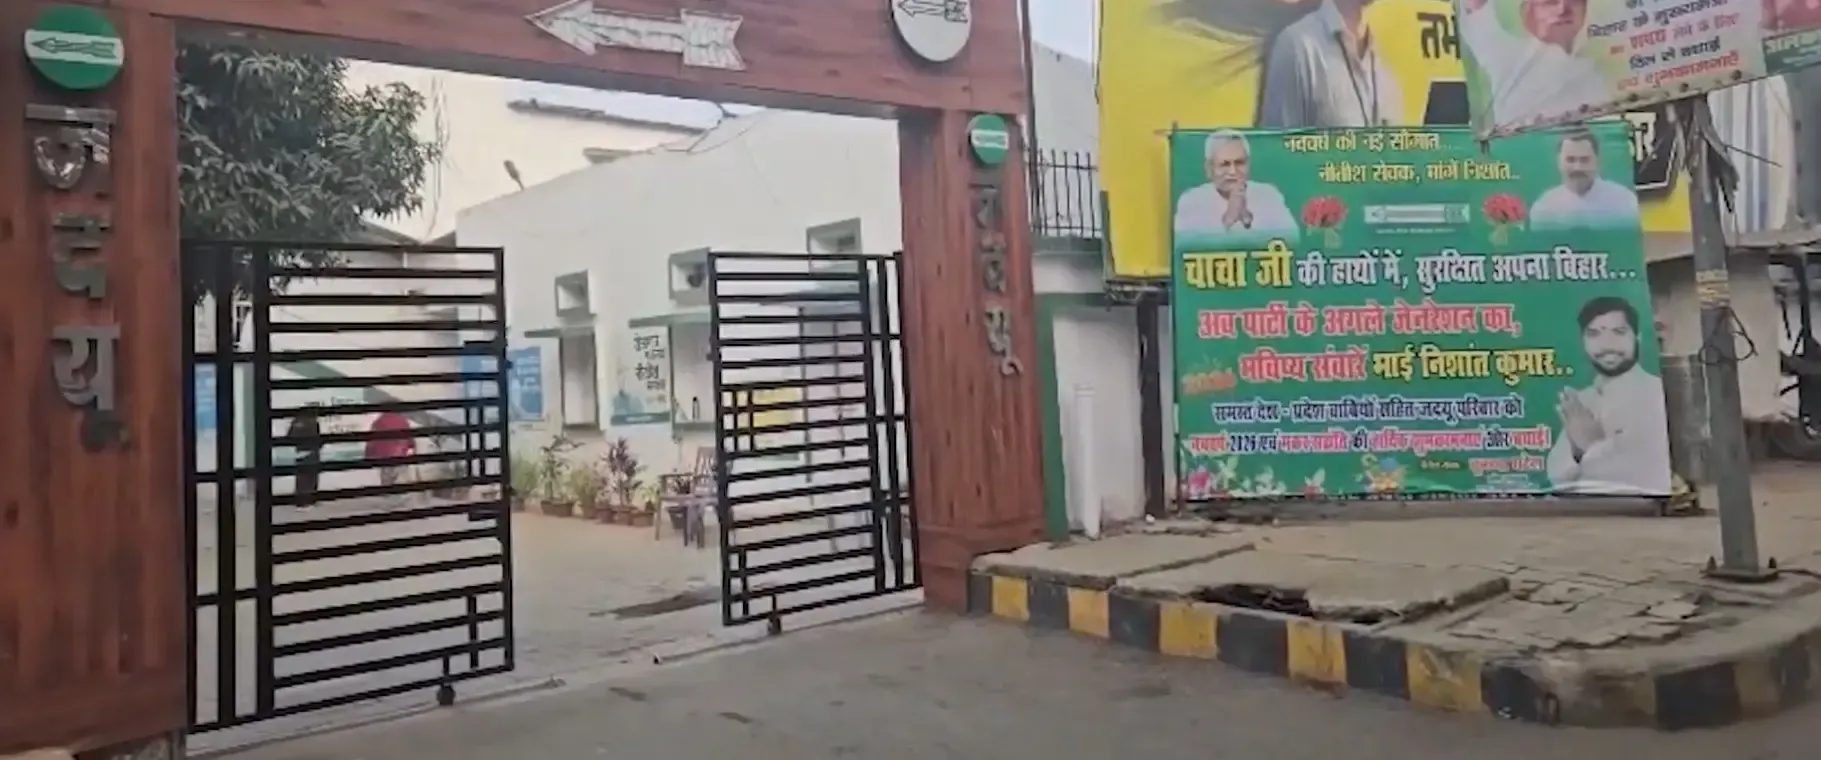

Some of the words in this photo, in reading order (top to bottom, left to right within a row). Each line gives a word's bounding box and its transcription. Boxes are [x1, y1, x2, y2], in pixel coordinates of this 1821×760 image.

[1336, 128, 1356, 152] की
[1363, 131, 1383, 153] नई
[1319, 160, 1366, 183] नीतीश
[1373, 159, 1421, 185] सेवक,
[1183, 251, 1248, 288] चाचा
[1252, 239, 1294, 288] जी
[1297, 250, 1326, 287] की
[1331, 247, 1380, 285] हाथों
[1382, 247, 1409, 289] में,
[1416, 247, 1487, 293] सुरक्षित
[1492, 252, 1550, 283] अपना
[1552, 245, 1637, 283] बिहार...
[1199, 310, 1237, 339] अब
[1238, 300, 1289, 338] पार्टी
[1293, 301, 1318, 337] के
[1323, 299, 1386, 337] अगले
[1392, 296, 1479, 335] जेनरेशन
[1483, 303, 1522, 338] का,
[1239, 346, 1306, 383] भविष्य
[1373, 343, 1417, 384] भाई
[1420, 343, 1491, 378] निशांत
[1495, 348, 1574, 386] कुमार..
[1212, 402, 1254, 424] समस्त
[1291, 396, 1327, 422] प्रदेश
[1379, 394, 1415, 420] सहित
[1416, 398, 1459, 425] जदयू
[1458, 392, 1501, 420] परिवार
[1503, 391, 1524, 419] को
[1230, 432, 1257, 453] 2026
[1258, 427, 1279, 453] एवं
[1351, 425, 1369, 453] की
[1486, 424, 1511, 451] और
